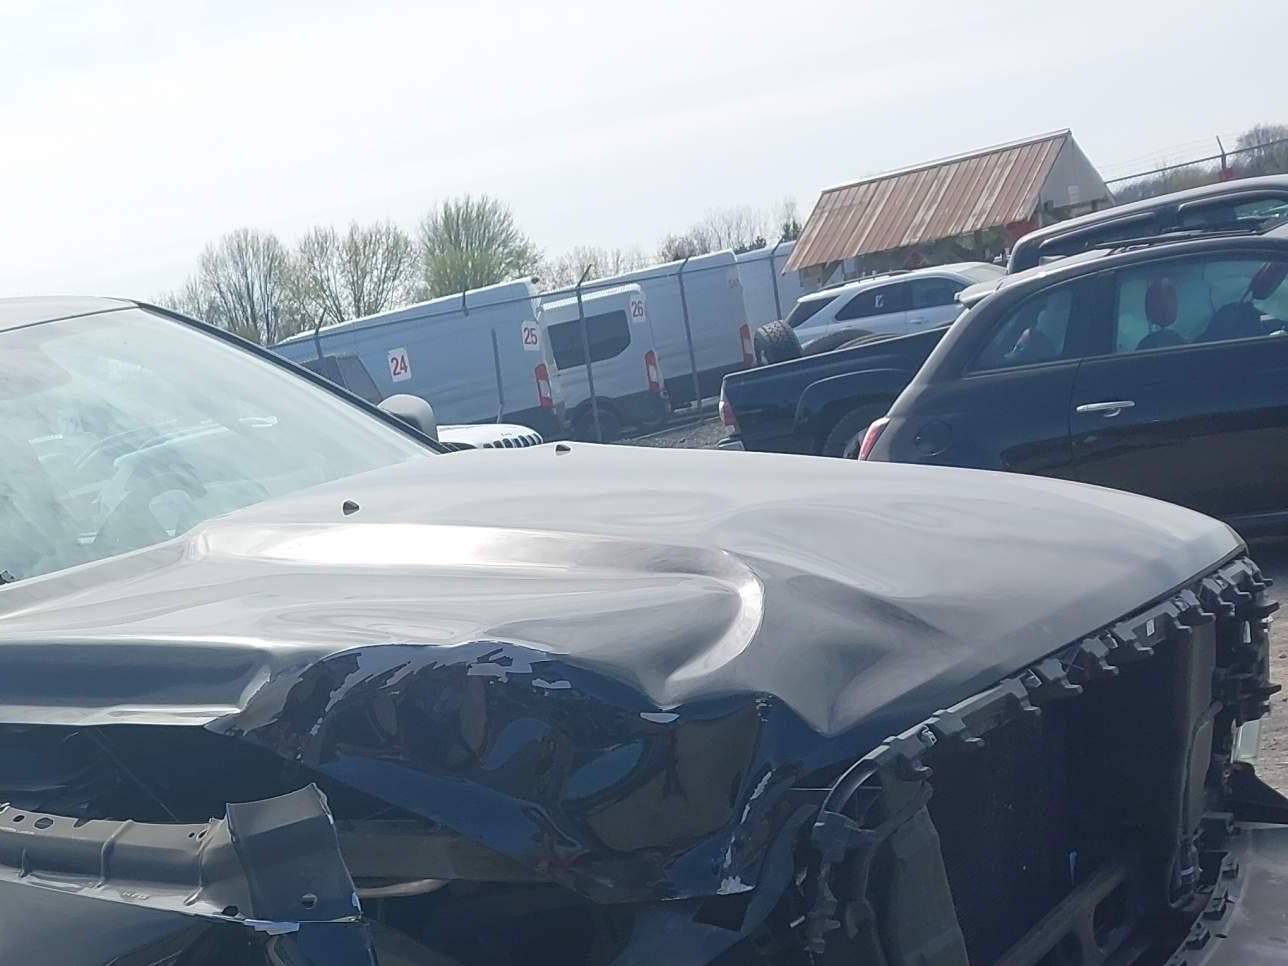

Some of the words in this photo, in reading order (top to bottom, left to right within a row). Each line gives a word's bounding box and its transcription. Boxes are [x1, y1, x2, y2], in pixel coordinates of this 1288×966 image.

[631, 300, 644, 318] 26
[522, 326, 539, 345] 25
[390, 354, 408, 377] 24
